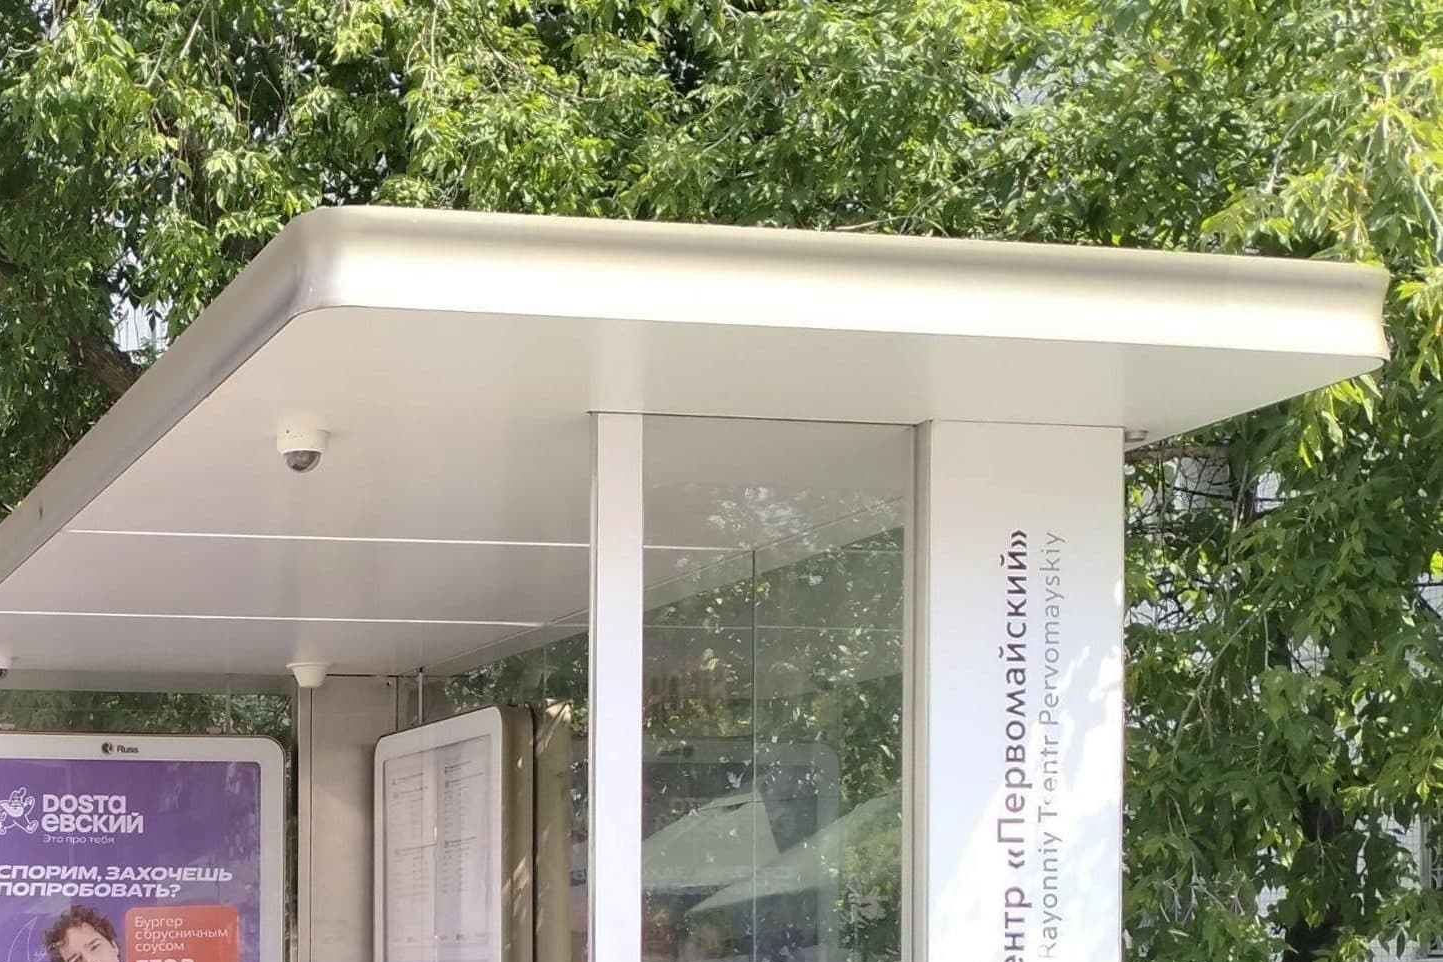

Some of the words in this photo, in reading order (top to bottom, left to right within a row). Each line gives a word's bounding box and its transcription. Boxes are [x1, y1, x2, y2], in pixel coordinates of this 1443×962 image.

[1039, 531, 1065, 726] Pervomayskiy
[997, 528, 1033, 869] «Первомайский»
[43, 834, 64, 843] Это
[66, 836, 87, 844] про
[89, 834, 115, 844] тебя
[105, 866, 233, 882] ЗАХОЧЕШЬ
[1037, 831, 1063, 958] Rayonniy
[134, 916, 183, 929] Бургер
[135, 942, 185, 954] соусом
